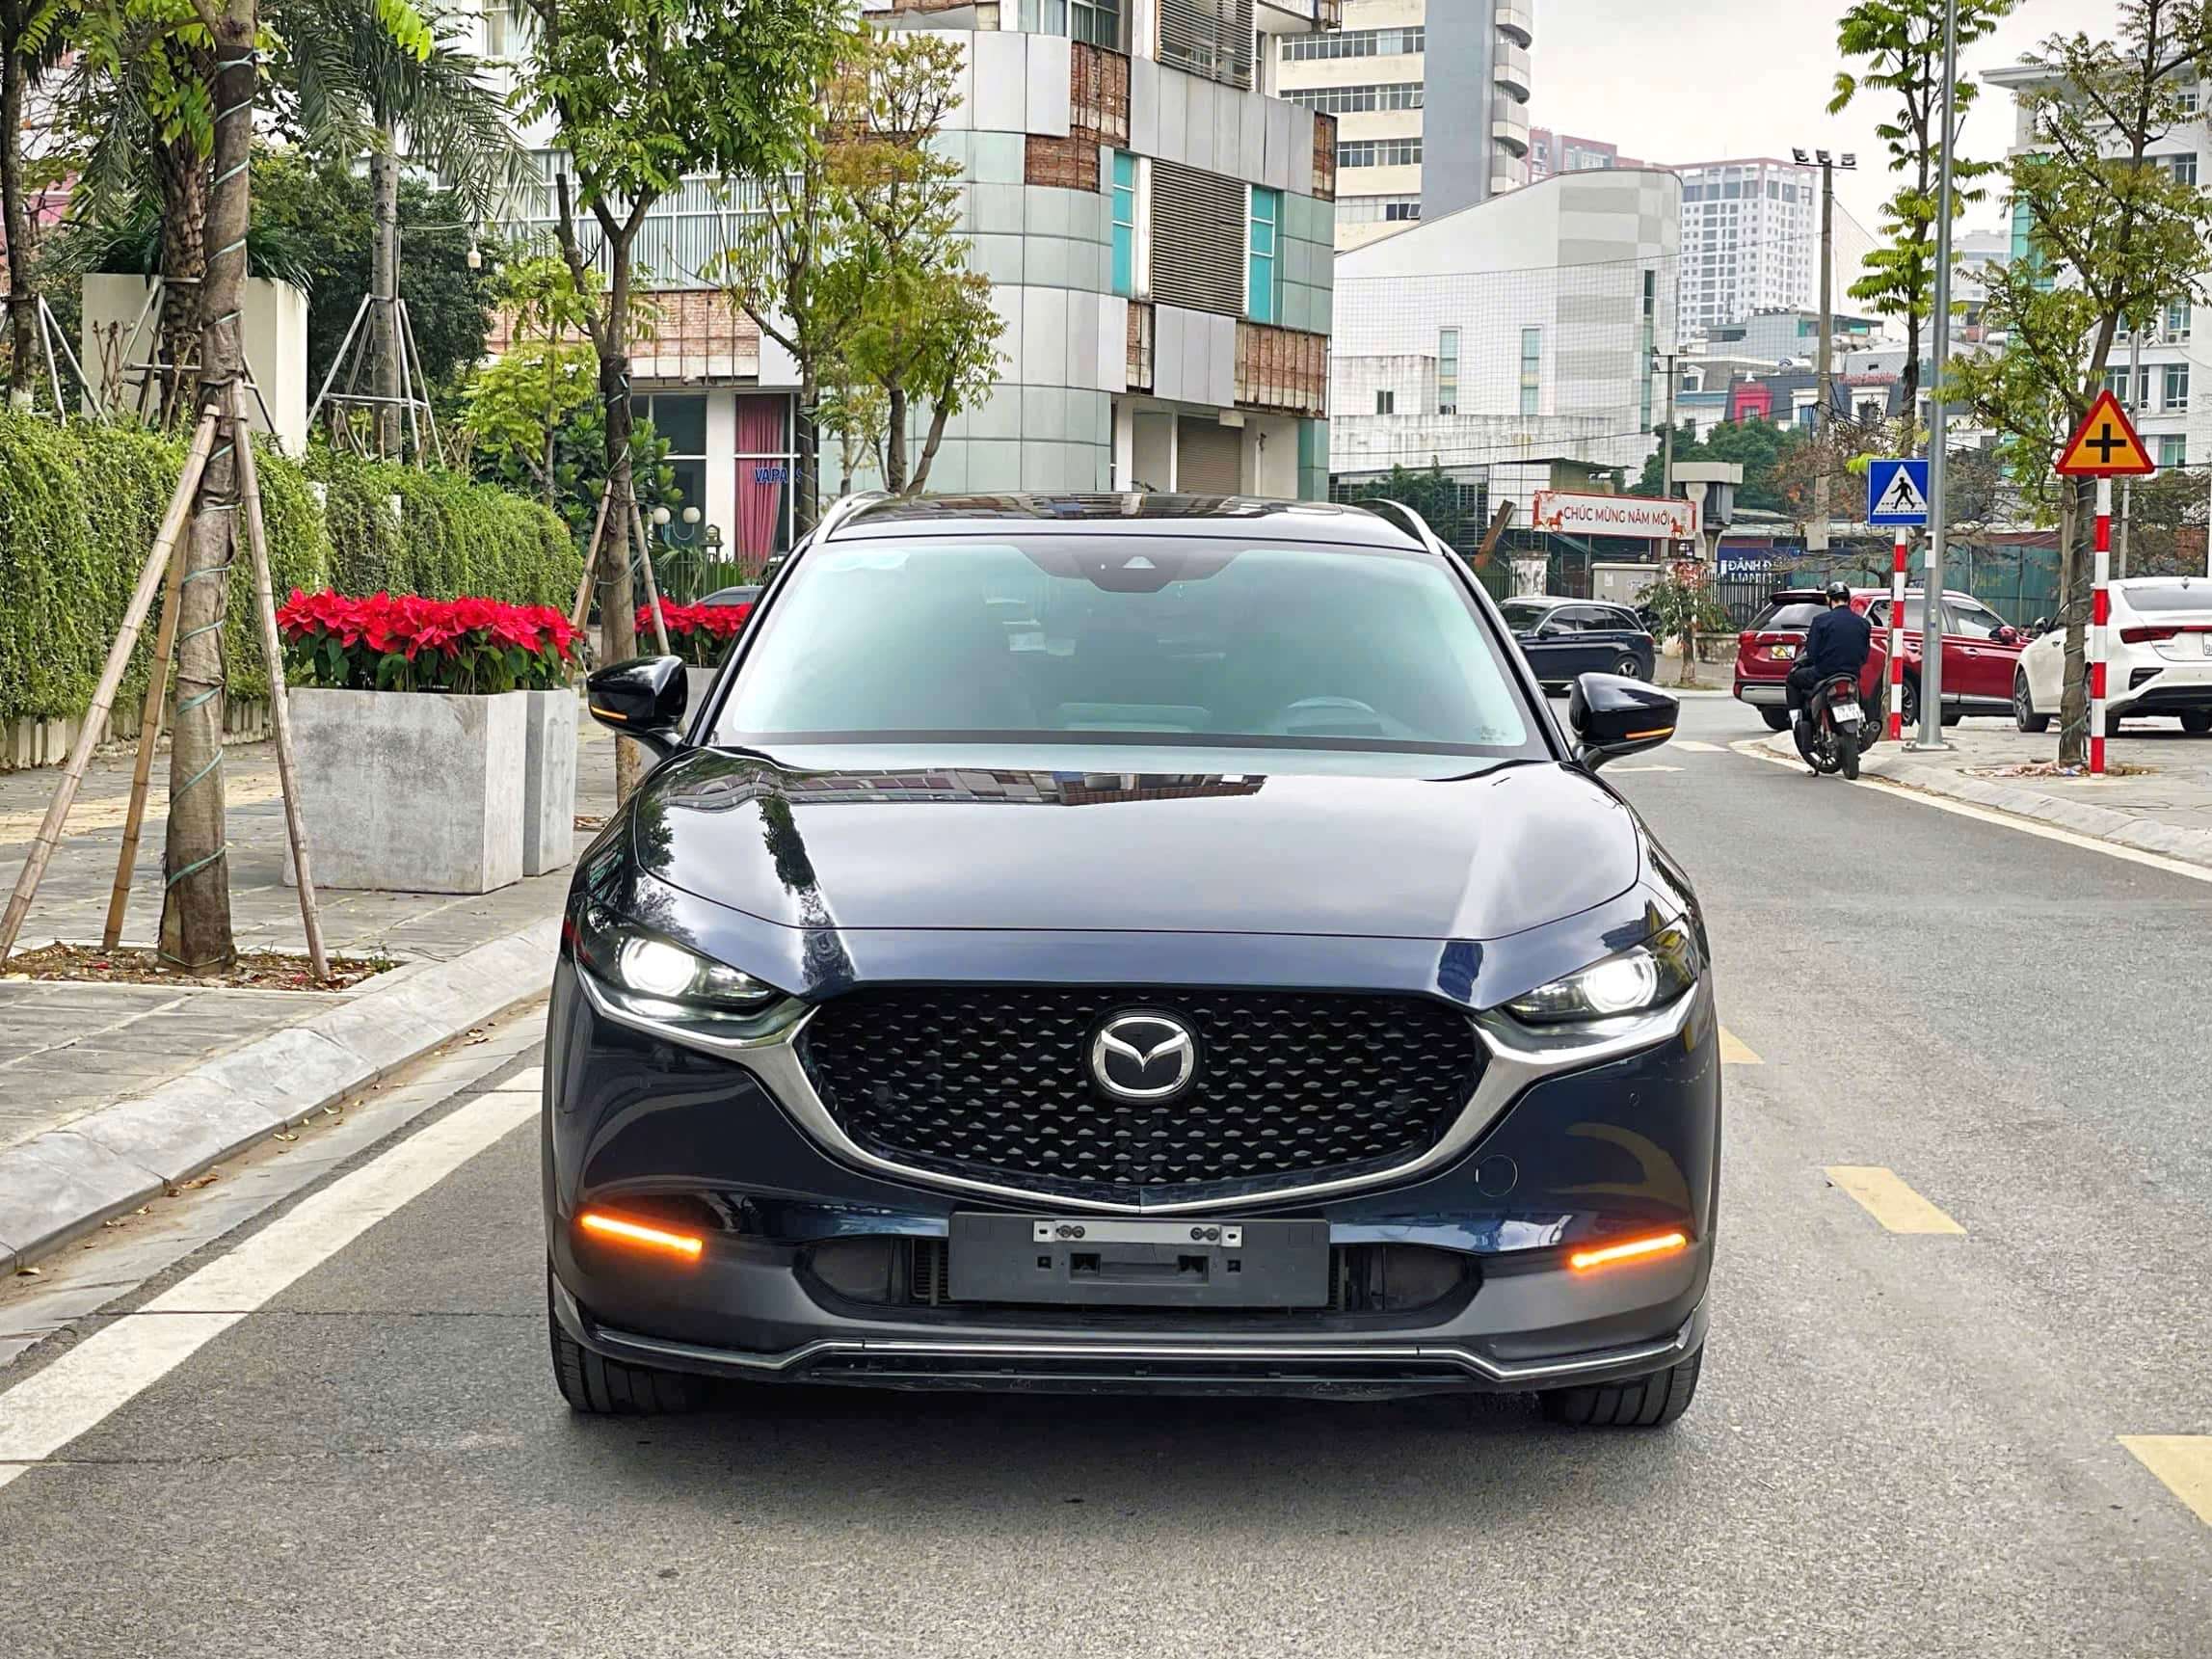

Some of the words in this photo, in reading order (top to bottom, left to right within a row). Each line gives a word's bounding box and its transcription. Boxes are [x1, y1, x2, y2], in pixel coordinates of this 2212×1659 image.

[1563, 504, 1593, 521] CHÚC
[1595, 505, 1626, 523] MỪNG
[1628, 508, 1650, 525] NĂM
[1652, 509, 1670, 525] MỚI
